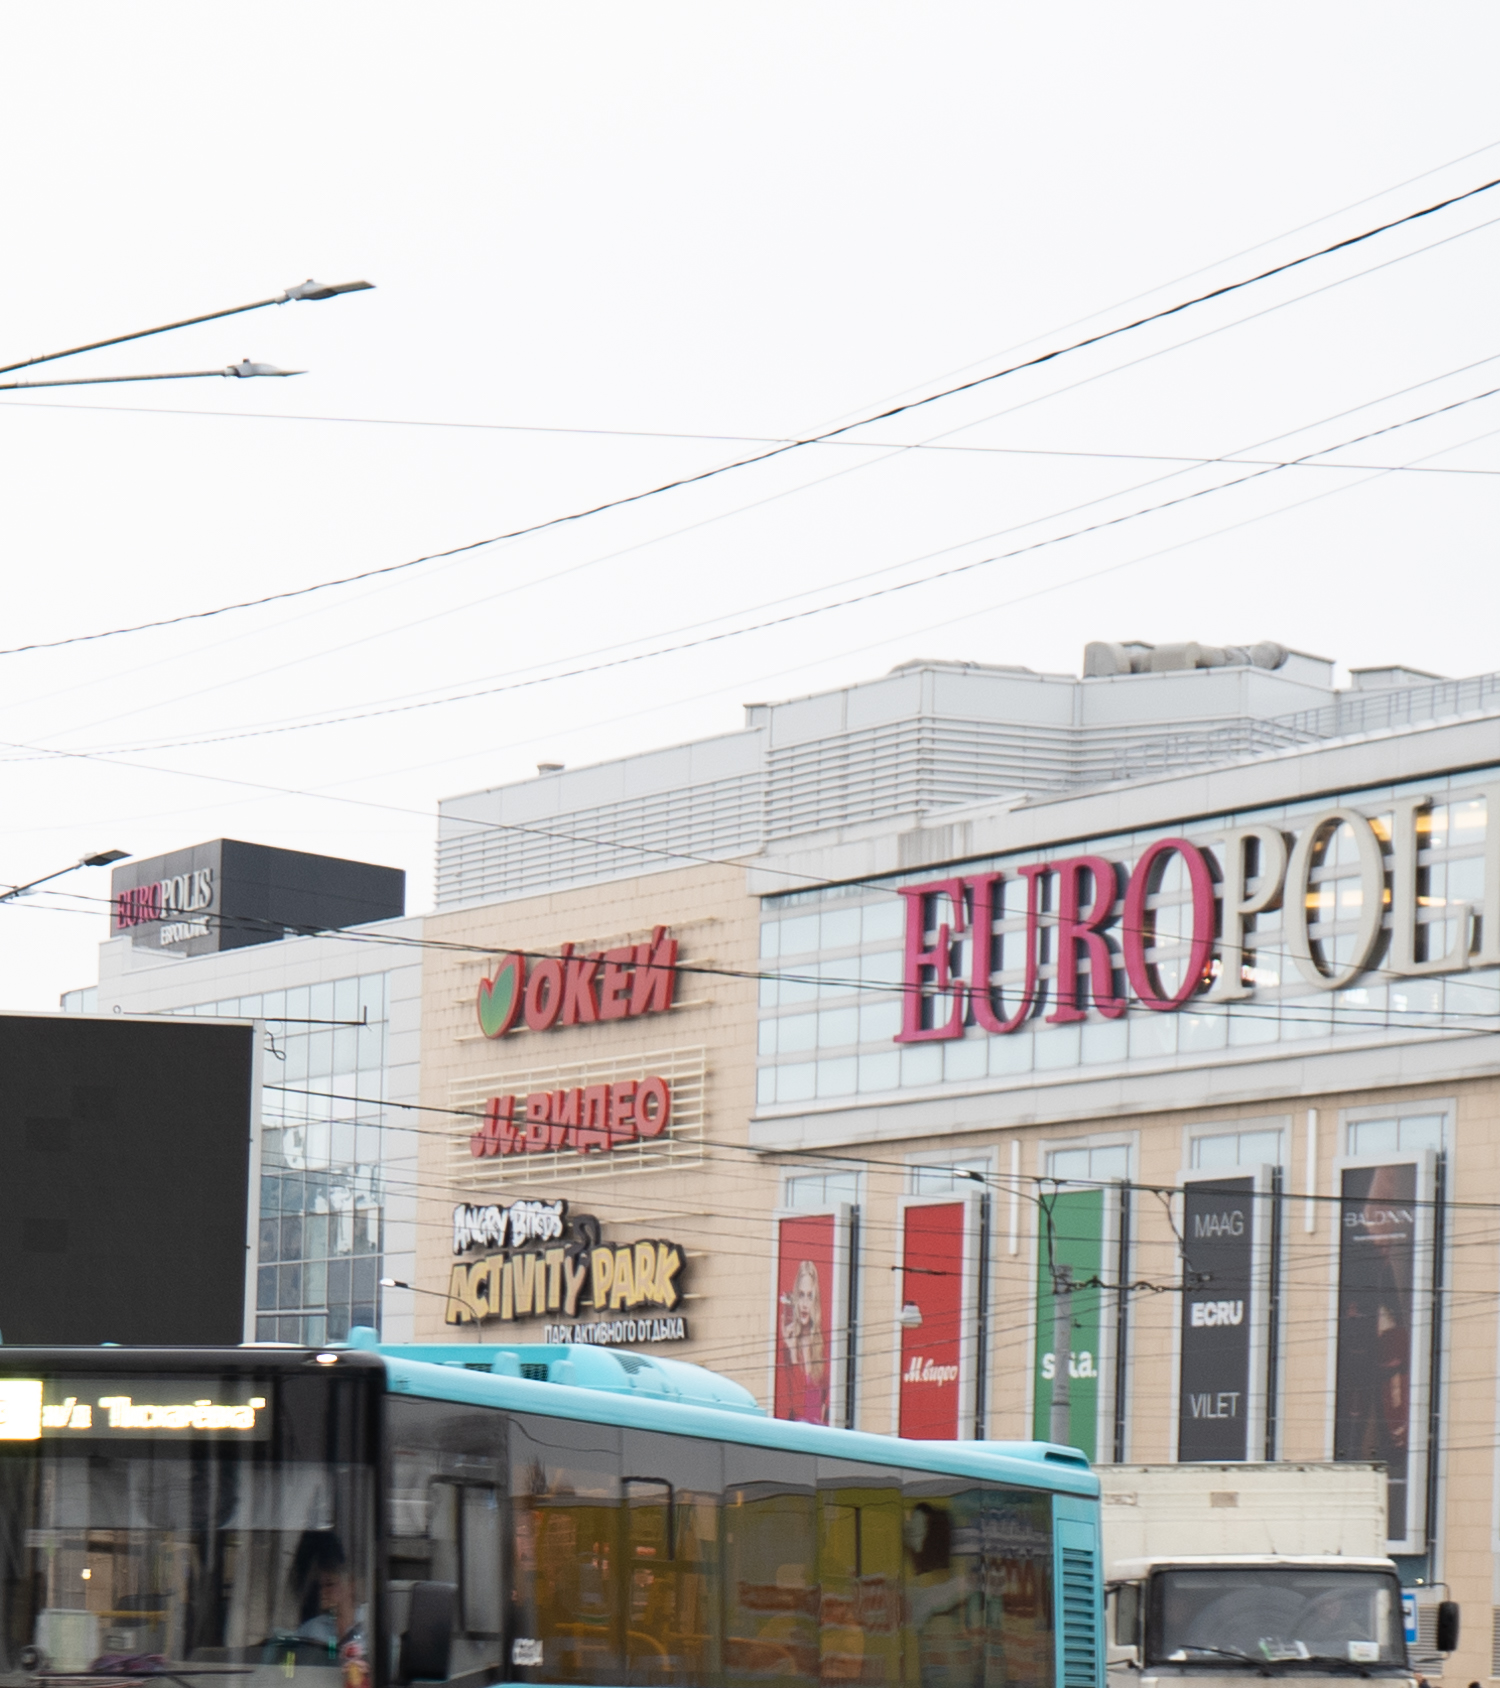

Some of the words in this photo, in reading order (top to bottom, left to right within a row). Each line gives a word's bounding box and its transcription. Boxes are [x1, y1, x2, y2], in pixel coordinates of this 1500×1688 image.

[117, 867, 213, 930] EUROPOLIS
[453, 1203, 509, 1255] ANGRY
[1194, 1210, 1244, 1238] MAAG
[591, 1241, 682, 1312] PARK
[1190, 1300, 1244, 1327] ECRU
[544, 1323, 573, 1344] ПАРК
[574, 1319, 637, 1344] АКТИВНОГО
[637, 1317, 686, 1341] ОТДЫХА
[1190, 1392, 1241, 1419] VILET
